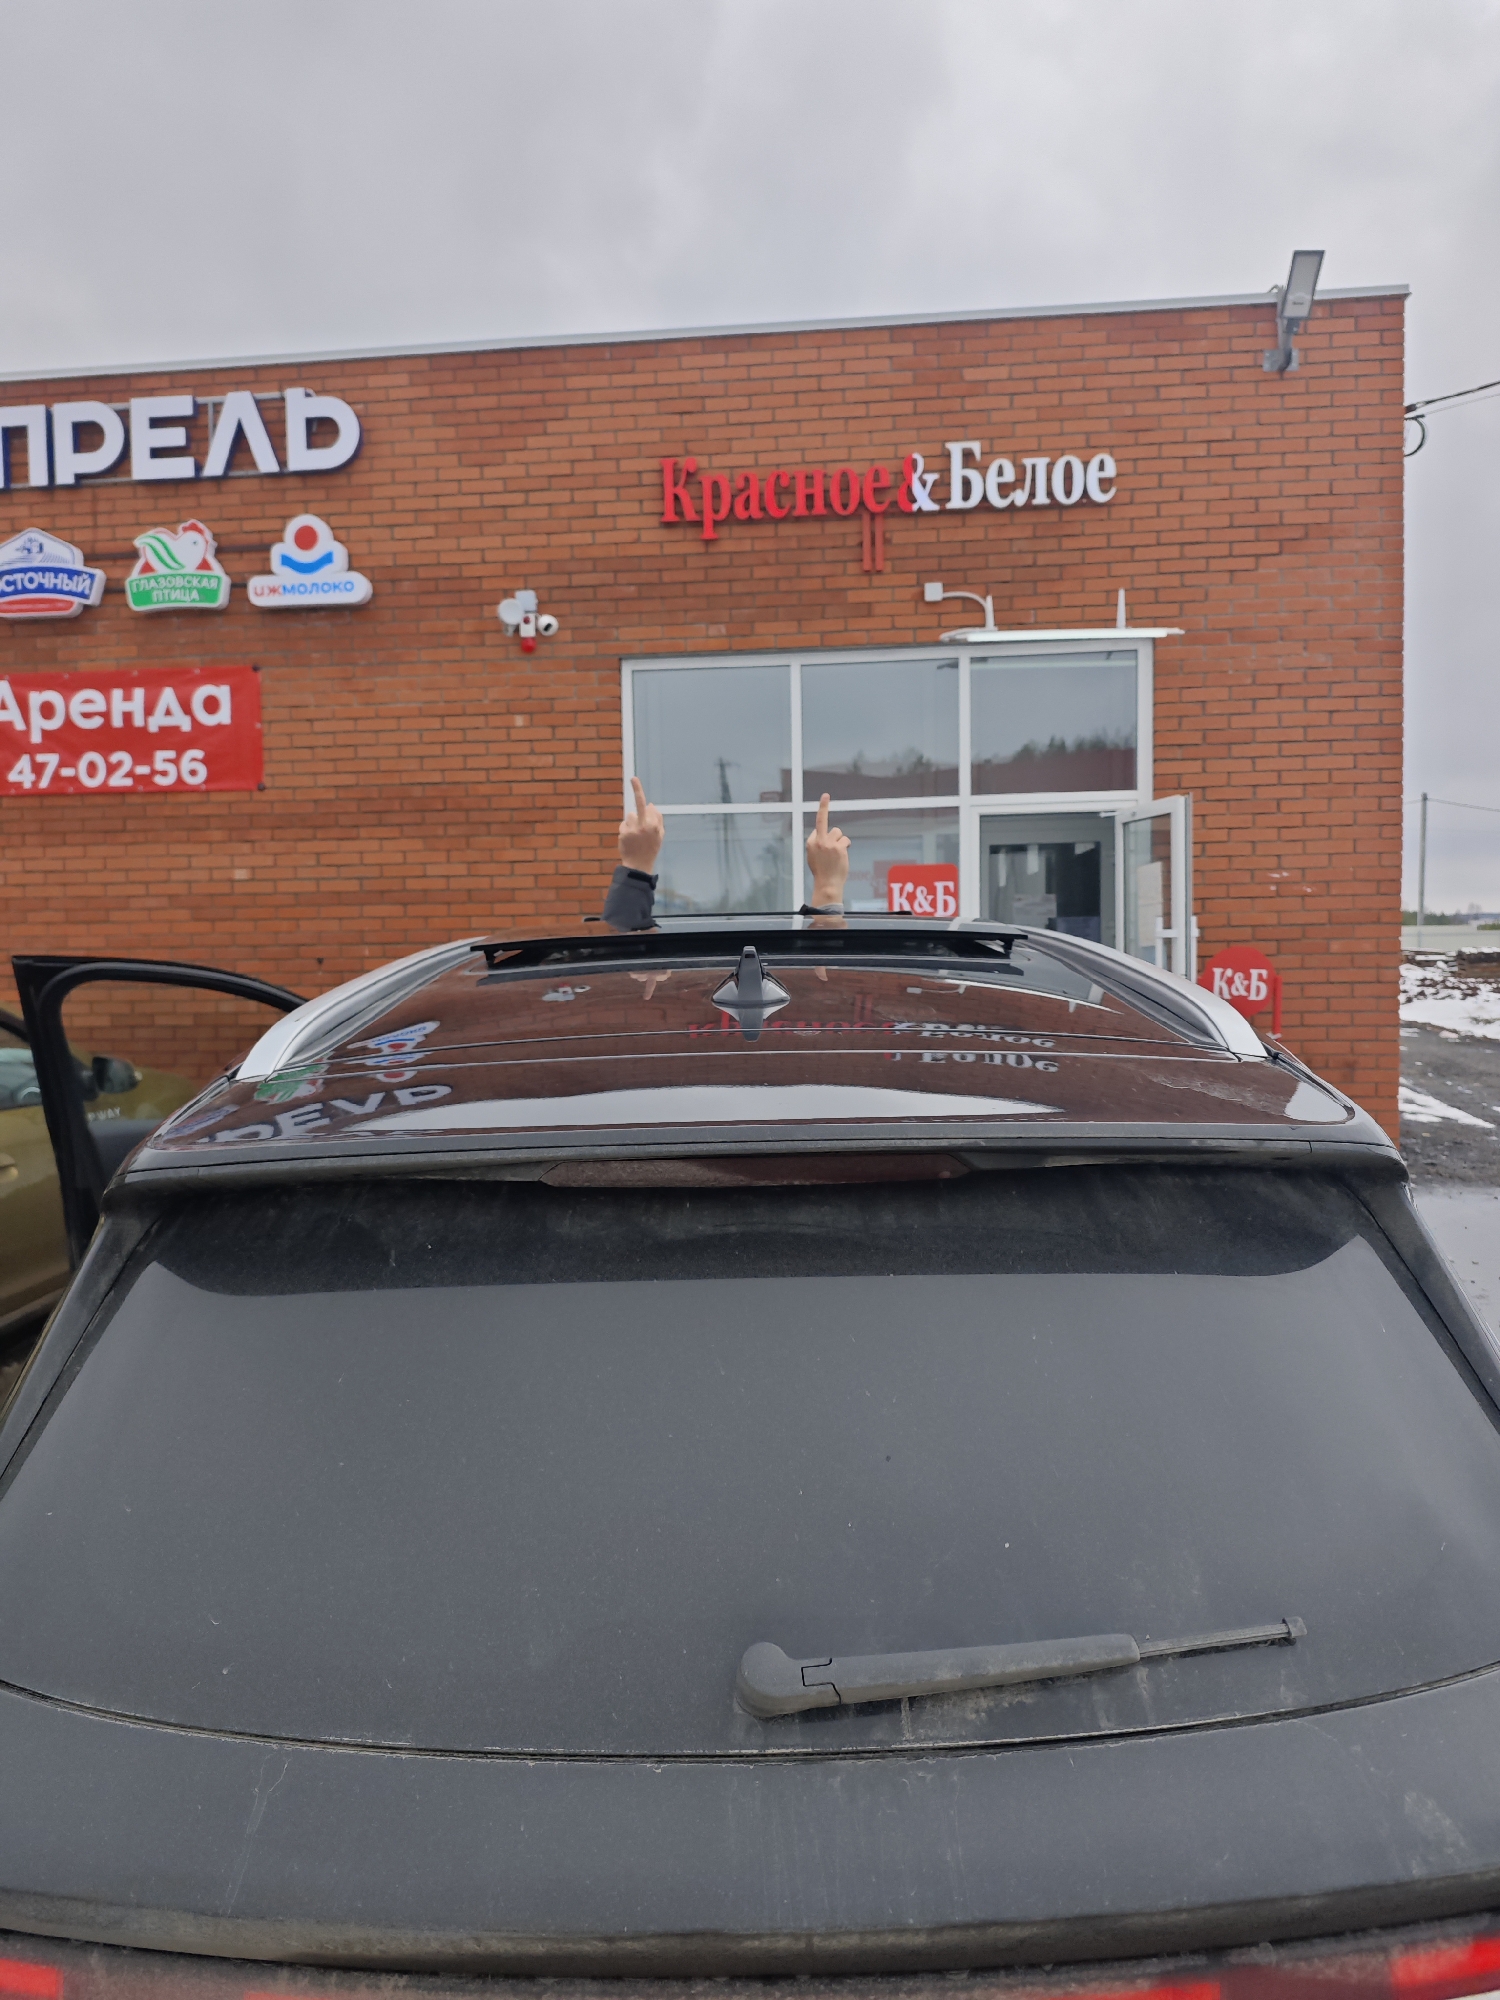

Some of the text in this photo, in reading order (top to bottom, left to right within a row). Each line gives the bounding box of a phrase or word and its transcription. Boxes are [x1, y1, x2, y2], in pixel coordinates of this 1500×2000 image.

[0, 387, 362, 490] ПРЕЛЬ
[130, 575, 219, 593] ГЛАЗОВСКАЯ
[152, 587, 201, 603] ПТИЦА
[7, 748, 208, 789] 47-02-56
[890, 881, 956, 917] К&Б
[1212, 967, 1268, 1001] К&Б
